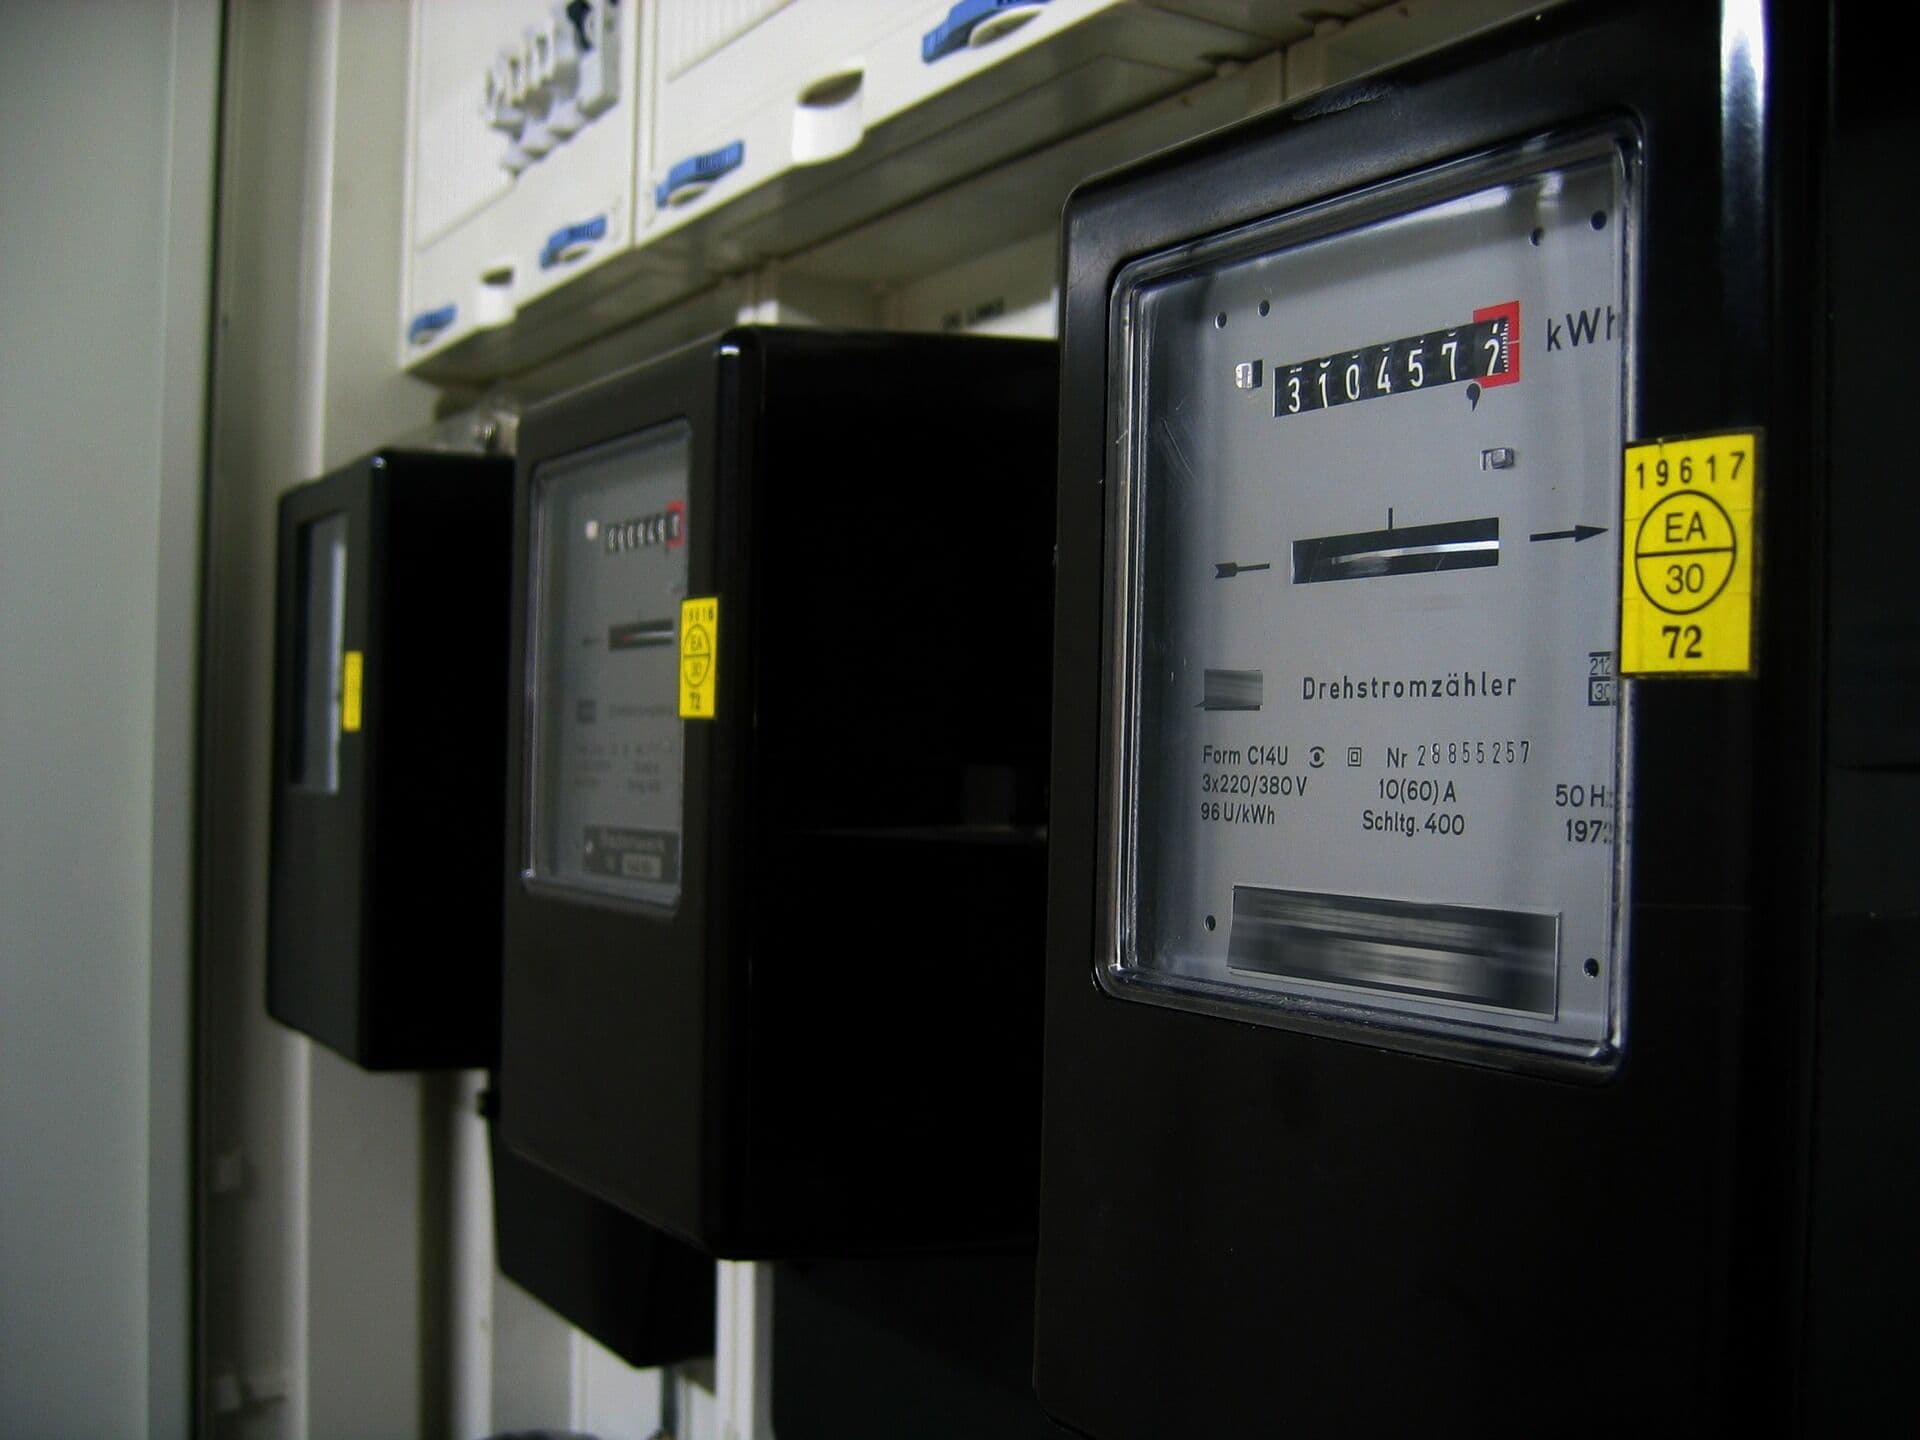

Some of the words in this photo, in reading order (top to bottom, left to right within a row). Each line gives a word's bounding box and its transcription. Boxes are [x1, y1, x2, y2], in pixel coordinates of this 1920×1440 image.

[1635, 451, 1746, 490] 19617
[1664, 511, 1706, 543] EA
[1664, 563, 1705, 595] 30
[1661, 624, 1703, 660] 72
[1302, 671, 1517, 700] Drehstromzähler
[1202, 745, 1242, 765] Form
[1247, 745, 1289, 766] C14U
[1386, 747, 1408, 769] Nr
[1417, 741, 1530, 767] 28855257
[1362, 809, 1420, 837] Schltg.
[1424, 812, 1465, 836] 400
